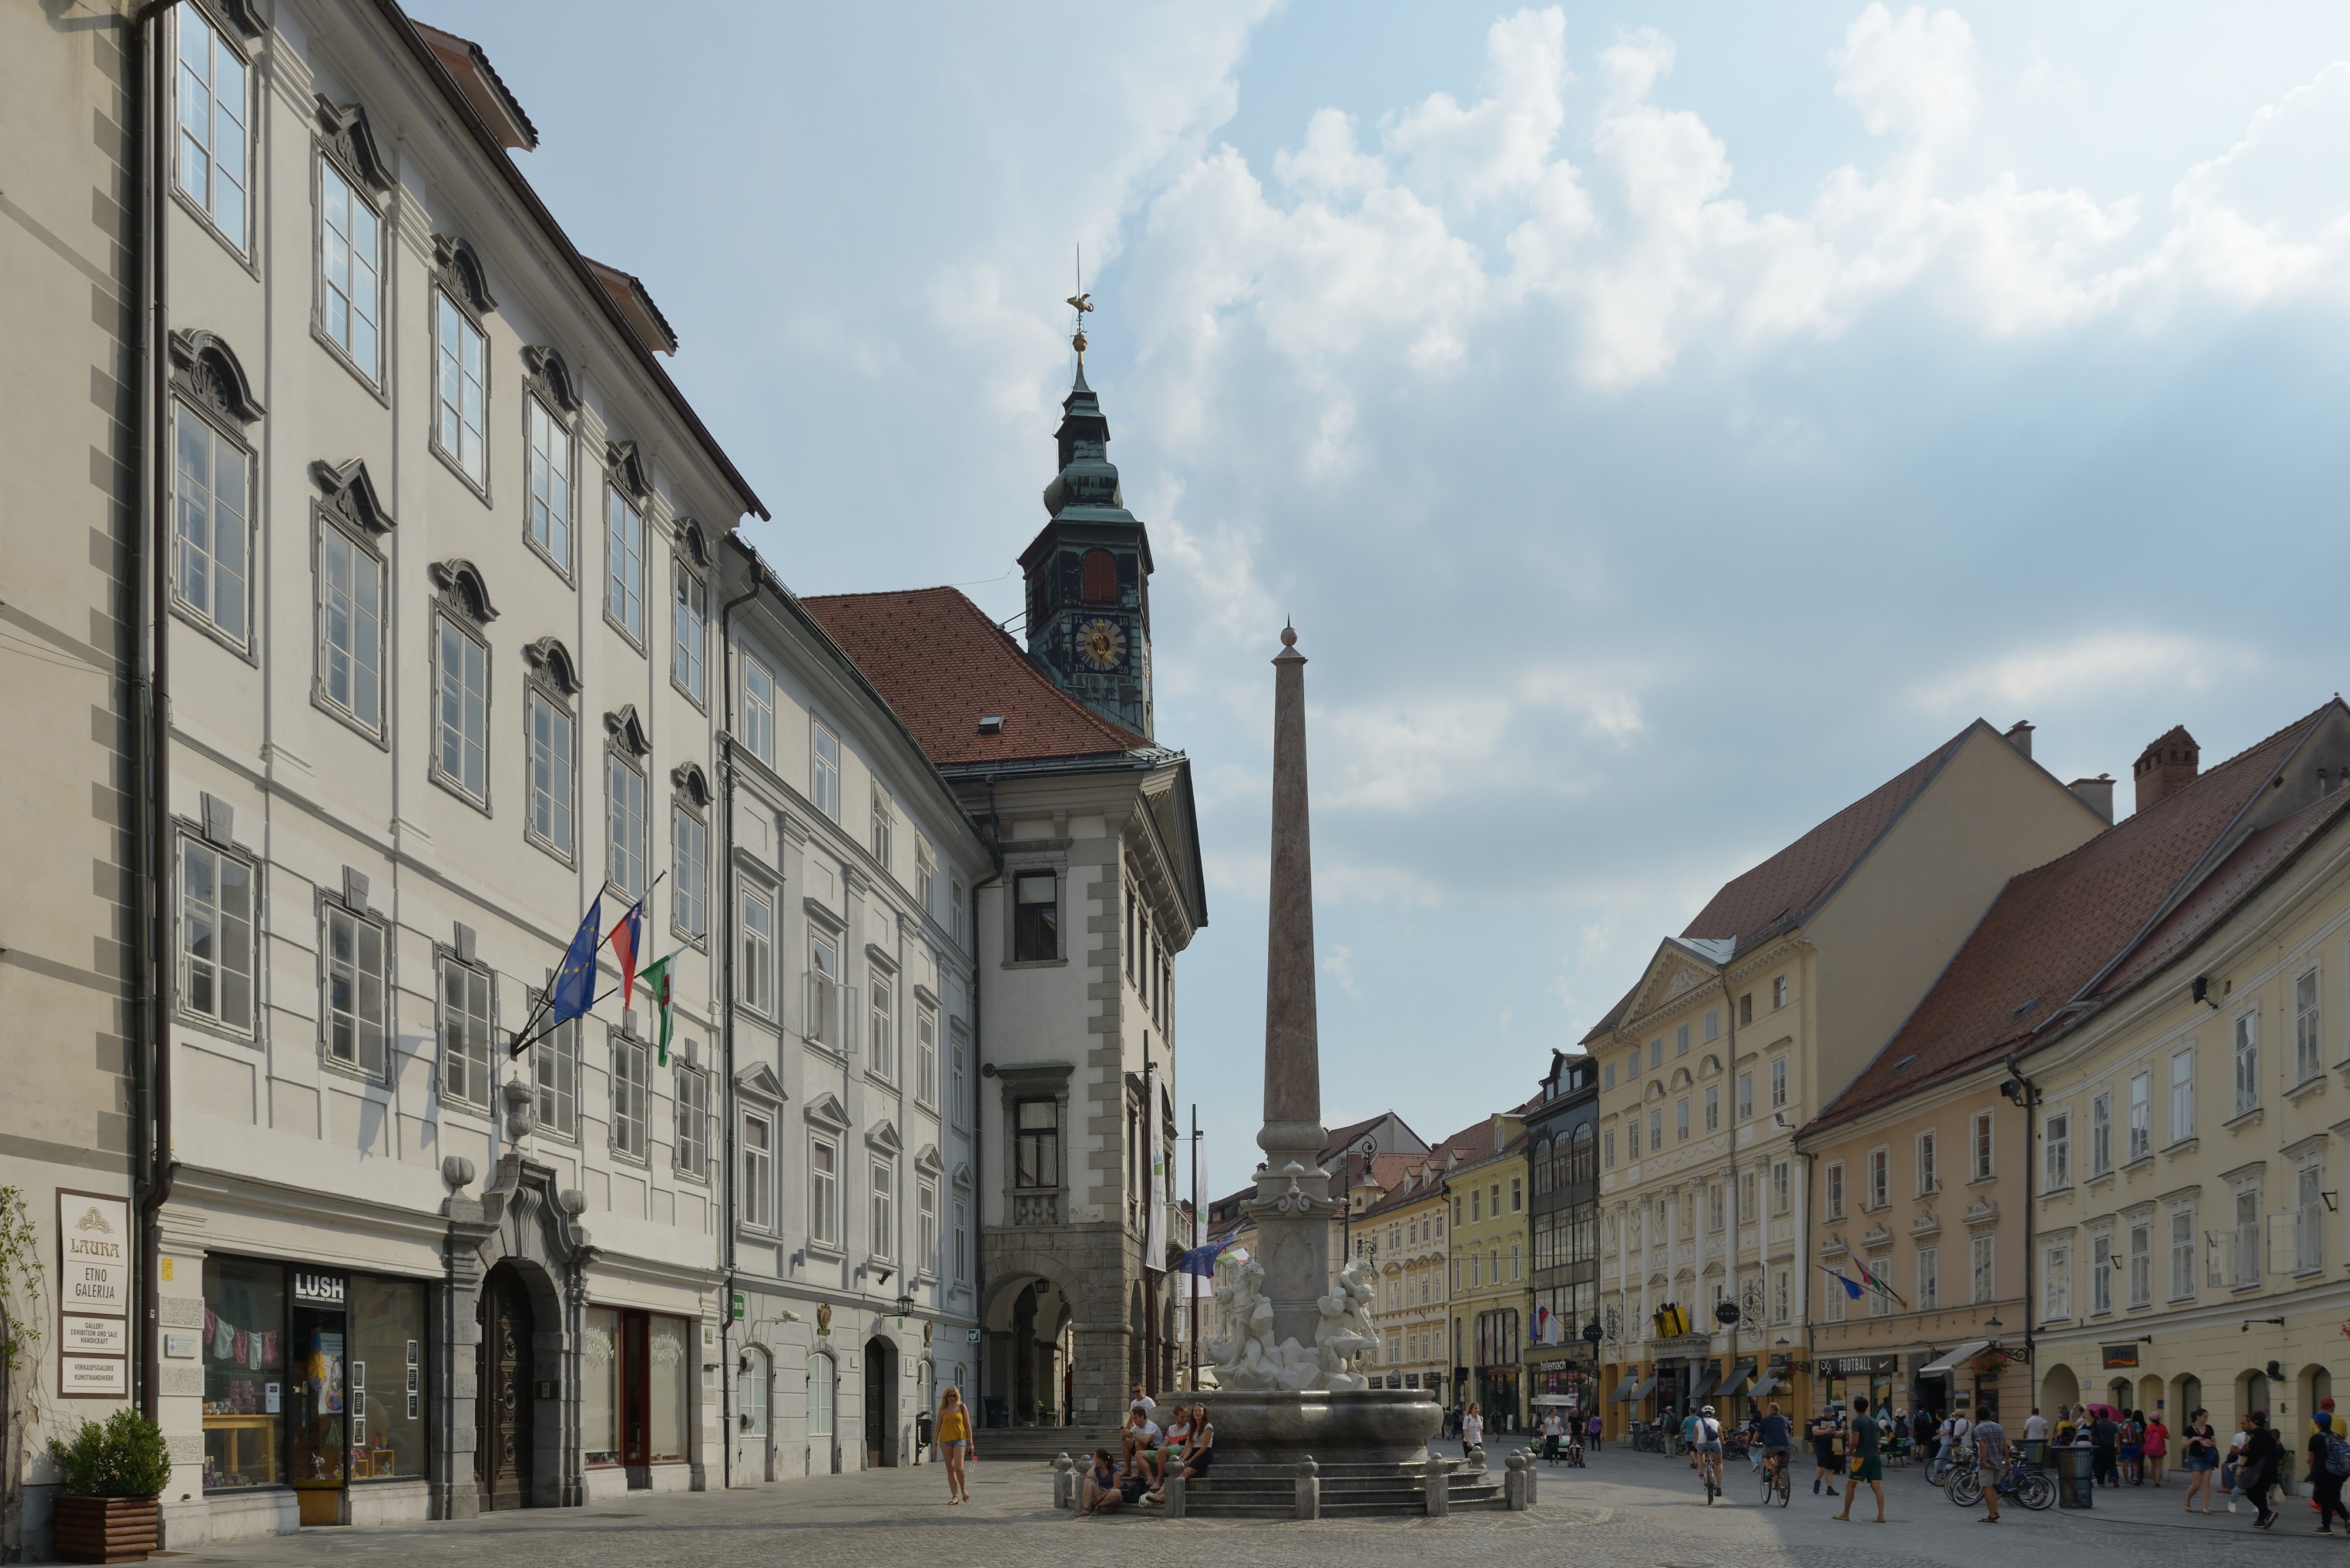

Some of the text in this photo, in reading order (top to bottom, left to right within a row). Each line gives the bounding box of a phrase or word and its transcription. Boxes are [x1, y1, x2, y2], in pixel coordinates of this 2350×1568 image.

[1074, 615, 1083, 624] 17
[1119, 617, 1128, 626] 18
[1074, 663, 1085, 672] 19
[1117, 665, 1129, 674] 28
[70, 1238, 120, 1258] LAURA
[86, 1267, 107, 1282] ETNO
[76, 1283, 115, 1299] GALERIJA
[296, 1273, 344, 1299] LUSH
[652, 1331, 683, 1358] CVETLIČARNA
[588, 1343, 608, 1364] OTOVŽ
[657, 1348, 679, 1364] ROTOVŽ
[2111, 1348, 2131, 1359] dm
[1540, 1358, 1566, 1371] telemach
[1839, 1357, 1871, 1372] FOOTBALL
